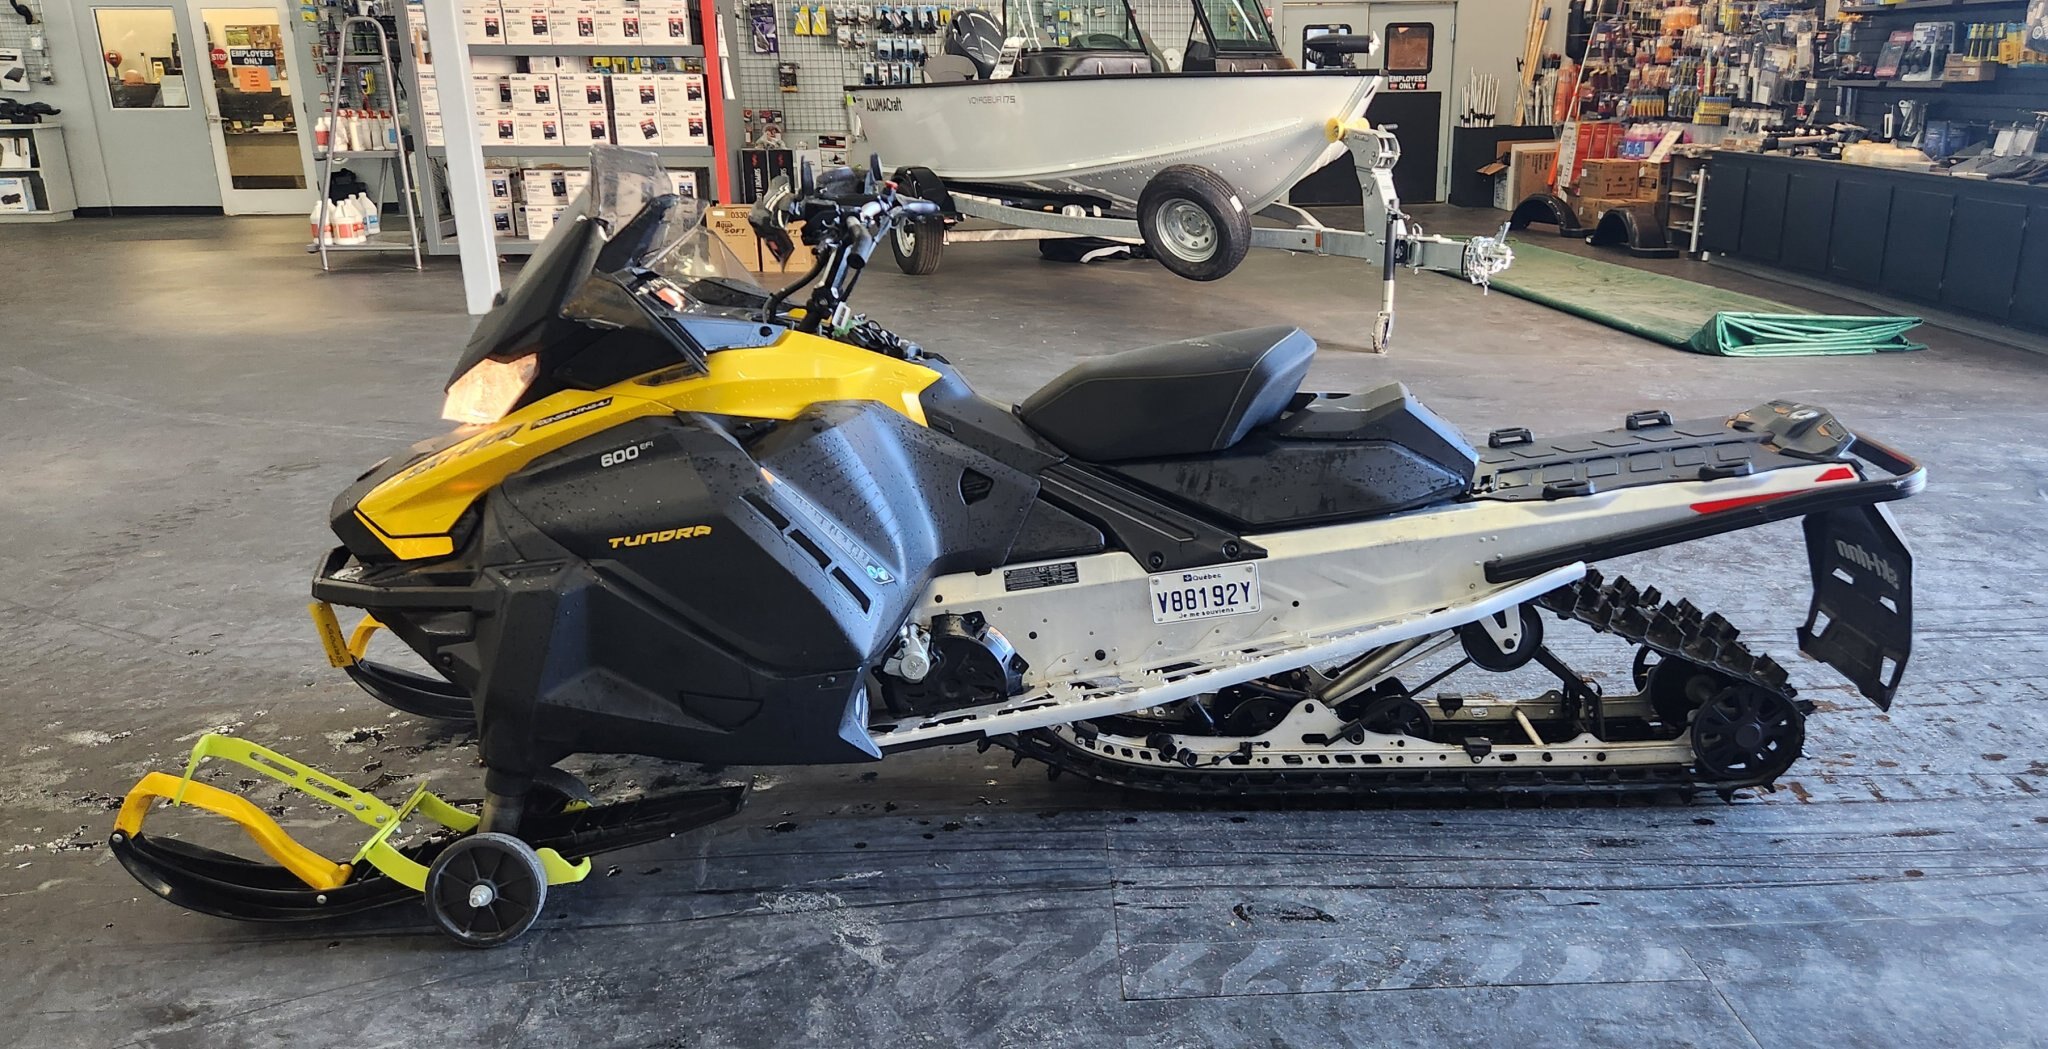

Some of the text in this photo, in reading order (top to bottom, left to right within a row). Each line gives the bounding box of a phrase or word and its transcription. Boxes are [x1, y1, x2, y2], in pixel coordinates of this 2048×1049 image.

[866, 96, 902, 111] ALUMACraft
[1002, 96, 1016, 104] 175
[600, 440, 654, 468] 600 EFI
[608, 526, 712, 549] TUNDRA
[1157, 581, 1250, 614] V88192Y
[1202, 607, 1234, 616] souviens
